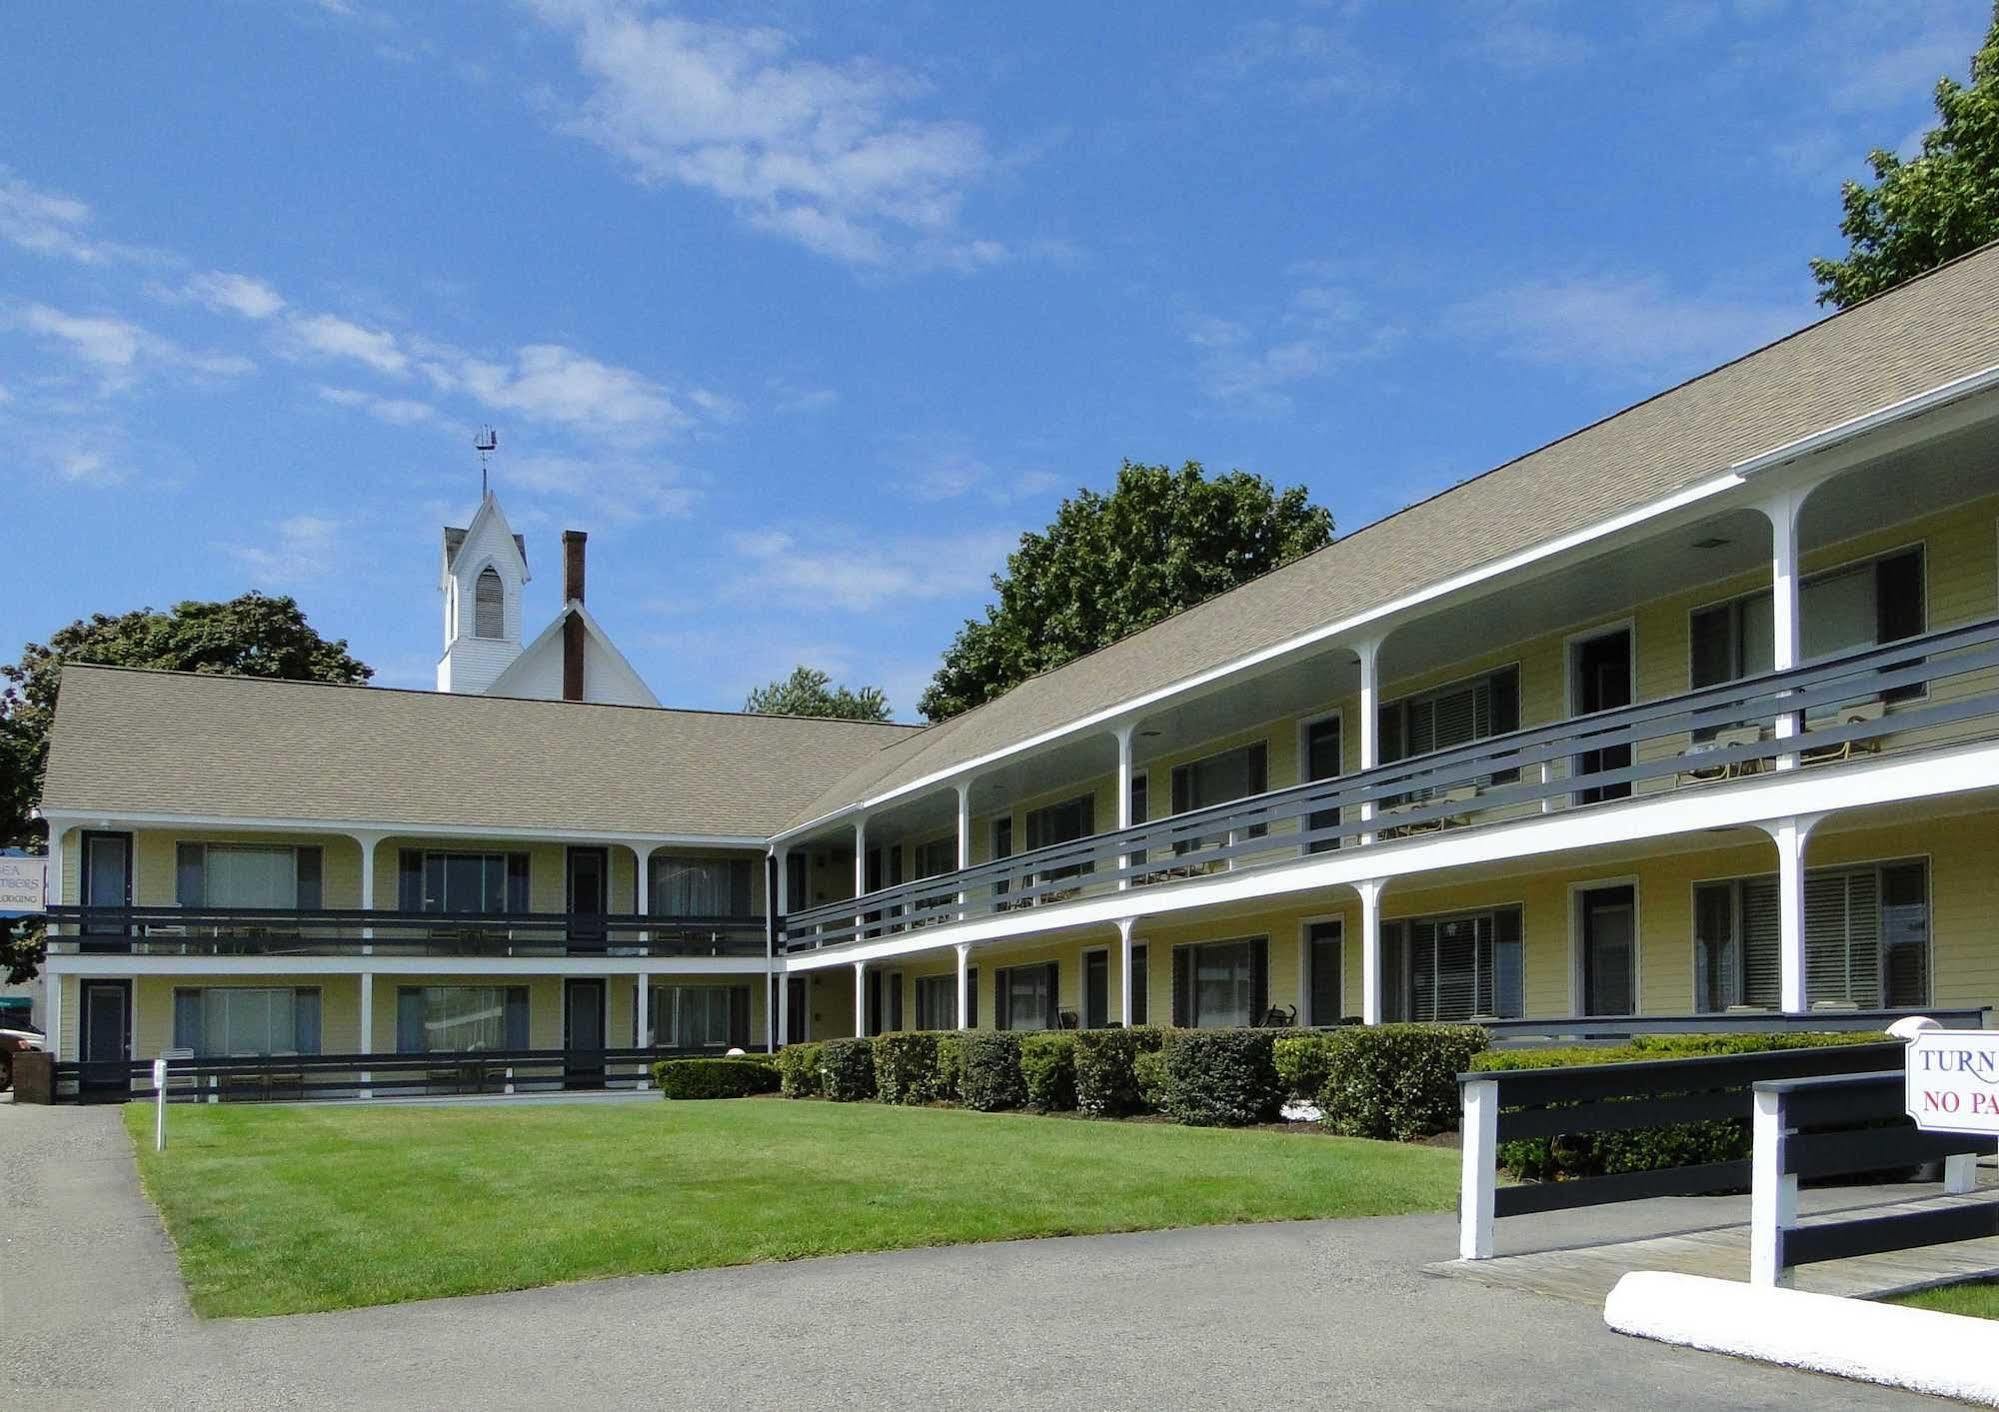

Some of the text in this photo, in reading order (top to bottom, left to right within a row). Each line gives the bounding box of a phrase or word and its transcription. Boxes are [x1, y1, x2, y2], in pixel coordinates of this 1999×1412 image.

[1919, 1049, 1999, 1083] TURN
[1923, 1090, 1999, 1114] NO PA
